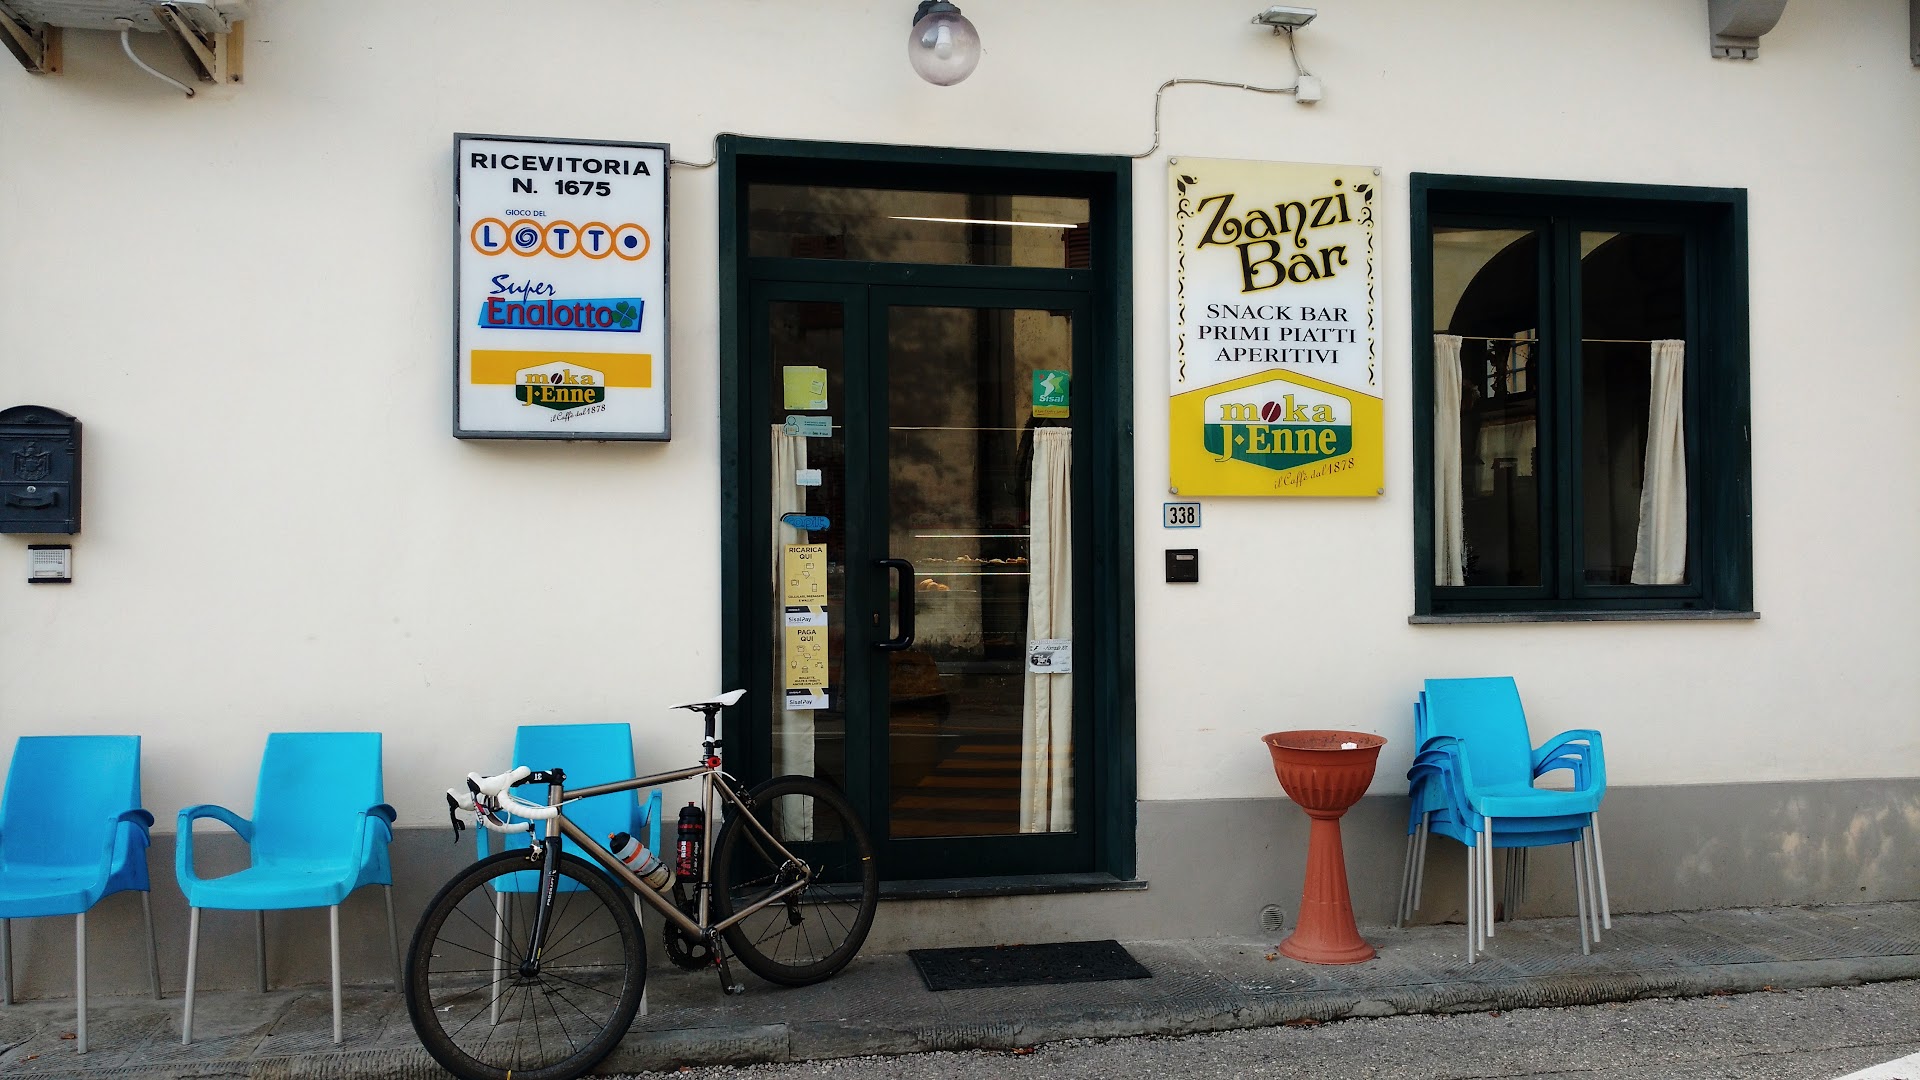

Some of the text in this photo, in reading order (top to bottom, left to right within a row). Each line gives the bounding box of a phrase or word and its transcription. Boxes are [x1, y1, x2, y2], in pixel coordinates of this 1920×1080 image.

[471, 152, 651, 176] RICEVITORIA
[512, 178, 611, 197] N. 1675
[1197, 179, 1351, 248] Zanzi
[1235, 239, 1348, 292] Bar
[490, 274, 556, 305] Super
[487, 297, 614, 328] Enalotto
[1207, 303, 1349, 322] SNACK BAR
[1198, 325, 1357, 343] PRIMI PIATTI
[1215, 347, 1339, 364] APERITIVI
[525, 369, 595, 385] moka
[1039, 394, 1064, 403] Sisal
[587, 404, 606, 414] 1878
[1220, 394, 1336, 423] moka
[1328, 458, 1355, 474] 1878
[1169, 506, 1195, 524] 338
